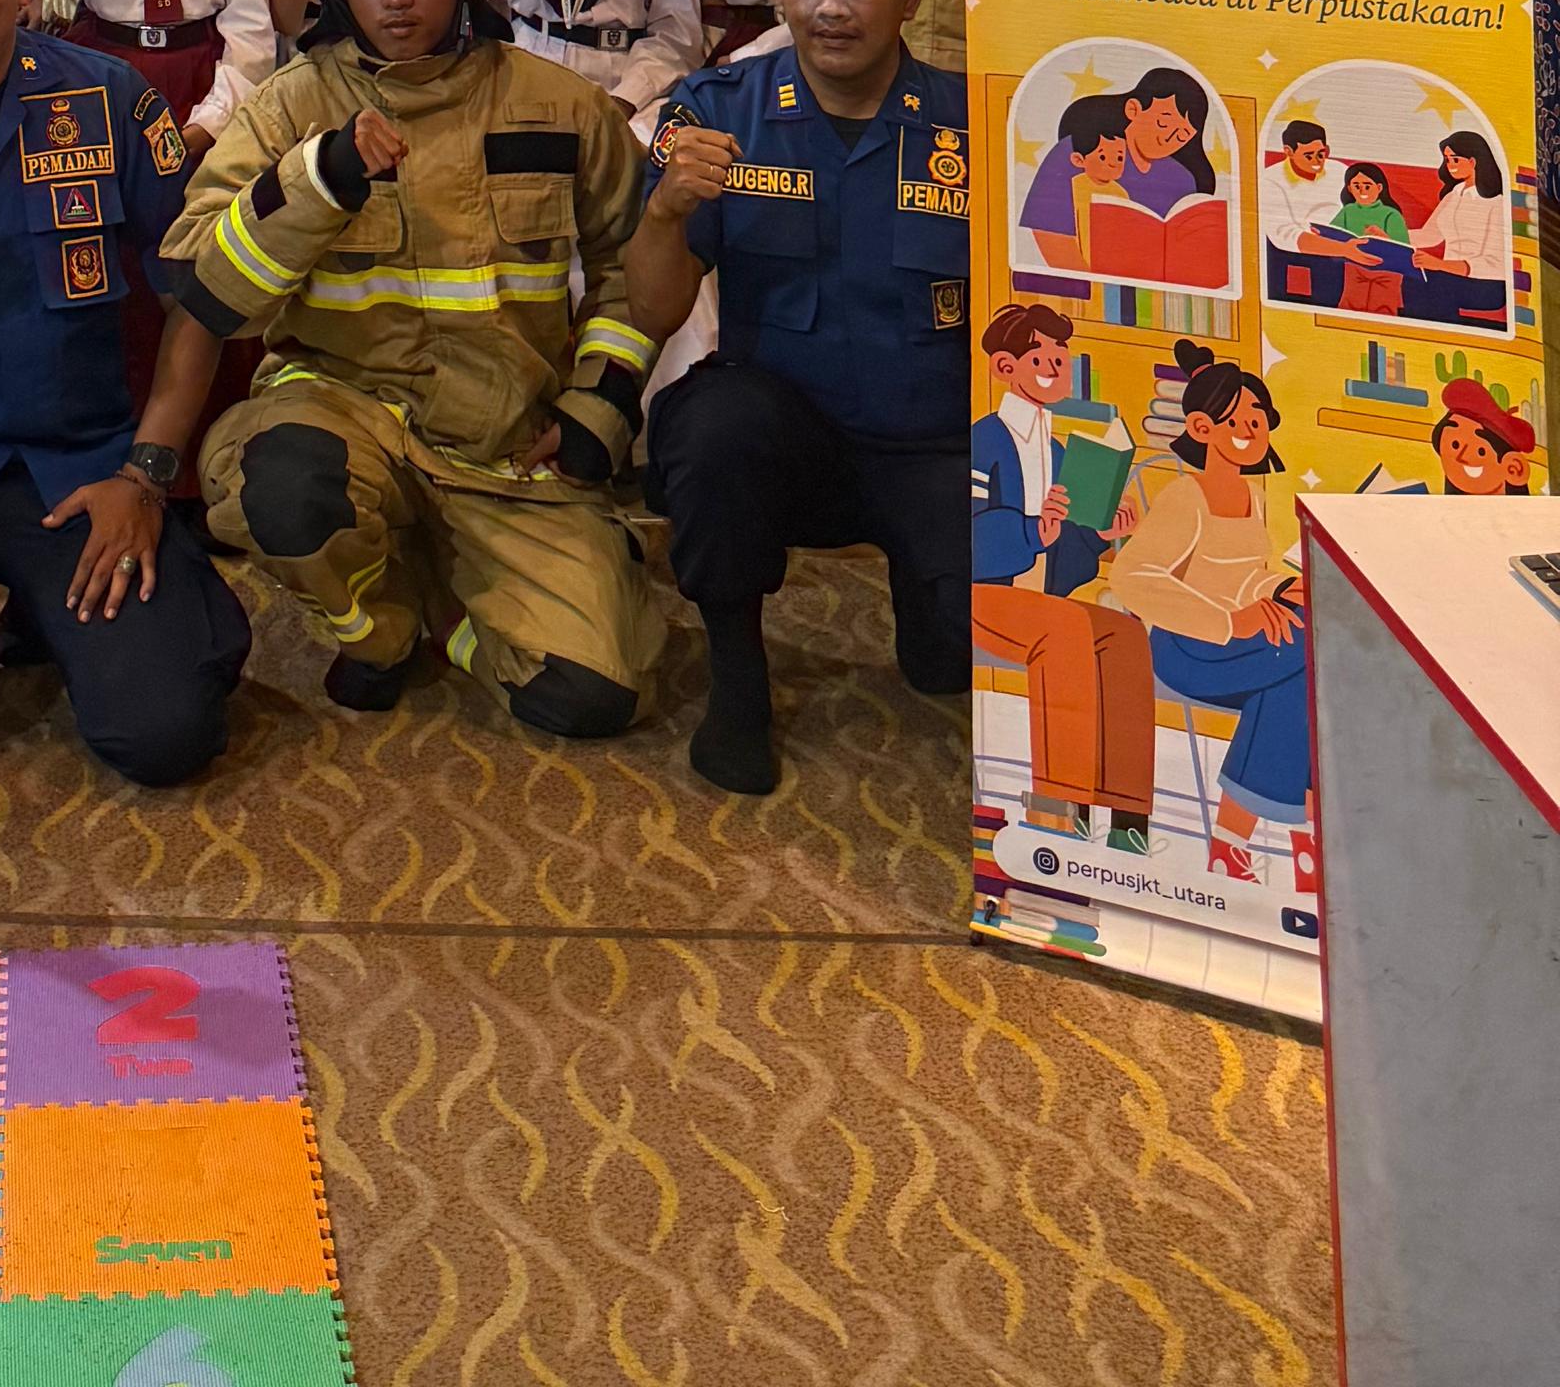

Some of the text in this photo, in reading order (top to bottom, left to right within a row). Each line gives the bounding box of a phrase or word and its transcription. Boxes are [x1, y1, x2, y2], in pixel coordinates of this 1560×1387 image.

[26, 149, 111, 177] PEMADAM
[1066, 857, 1228, 912] perpusjkt_utara
[89, 964, 201, 1045] 2
[94, 1235, 234, 1264] Seven
